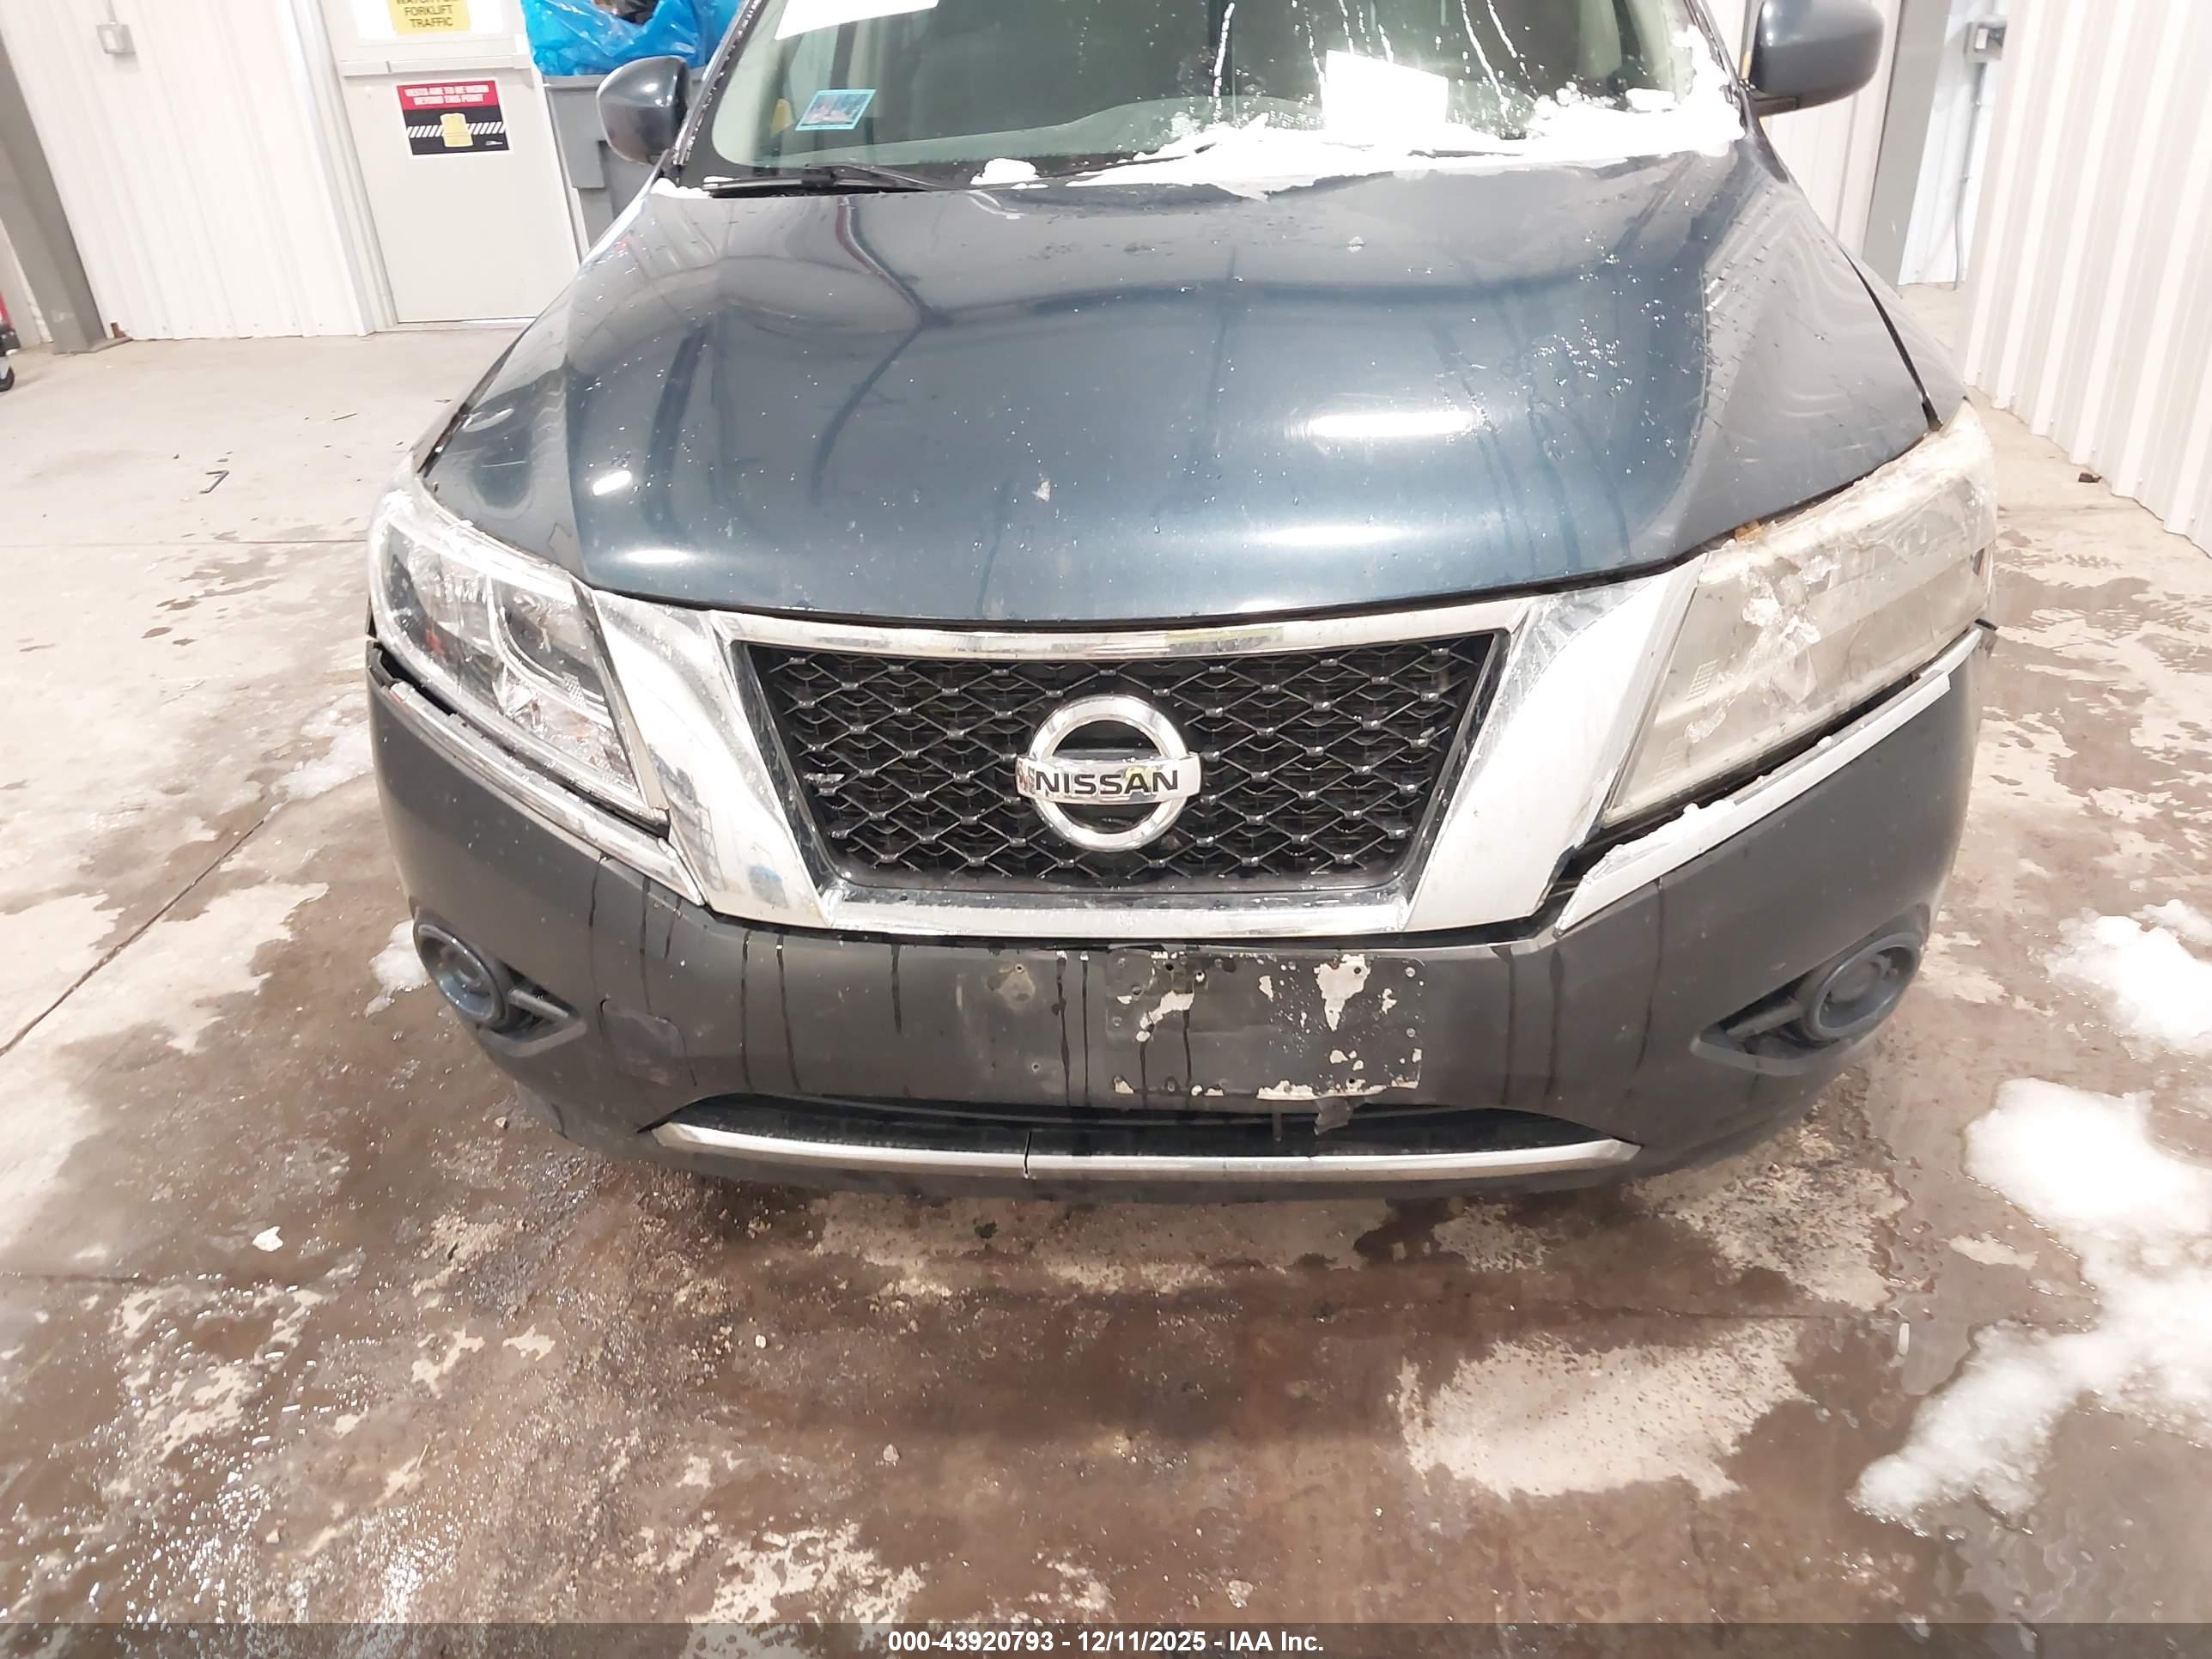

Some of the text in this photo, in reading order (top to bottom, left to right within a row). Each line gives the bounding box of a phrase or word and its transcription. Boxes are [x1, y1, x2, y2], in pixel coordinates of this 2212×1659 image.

[404, 5, 453, 15] FORKLIFT
[409, 17, 453, 27] TRAFFIC
[1036, 770, 1178, 795] NISSAN
